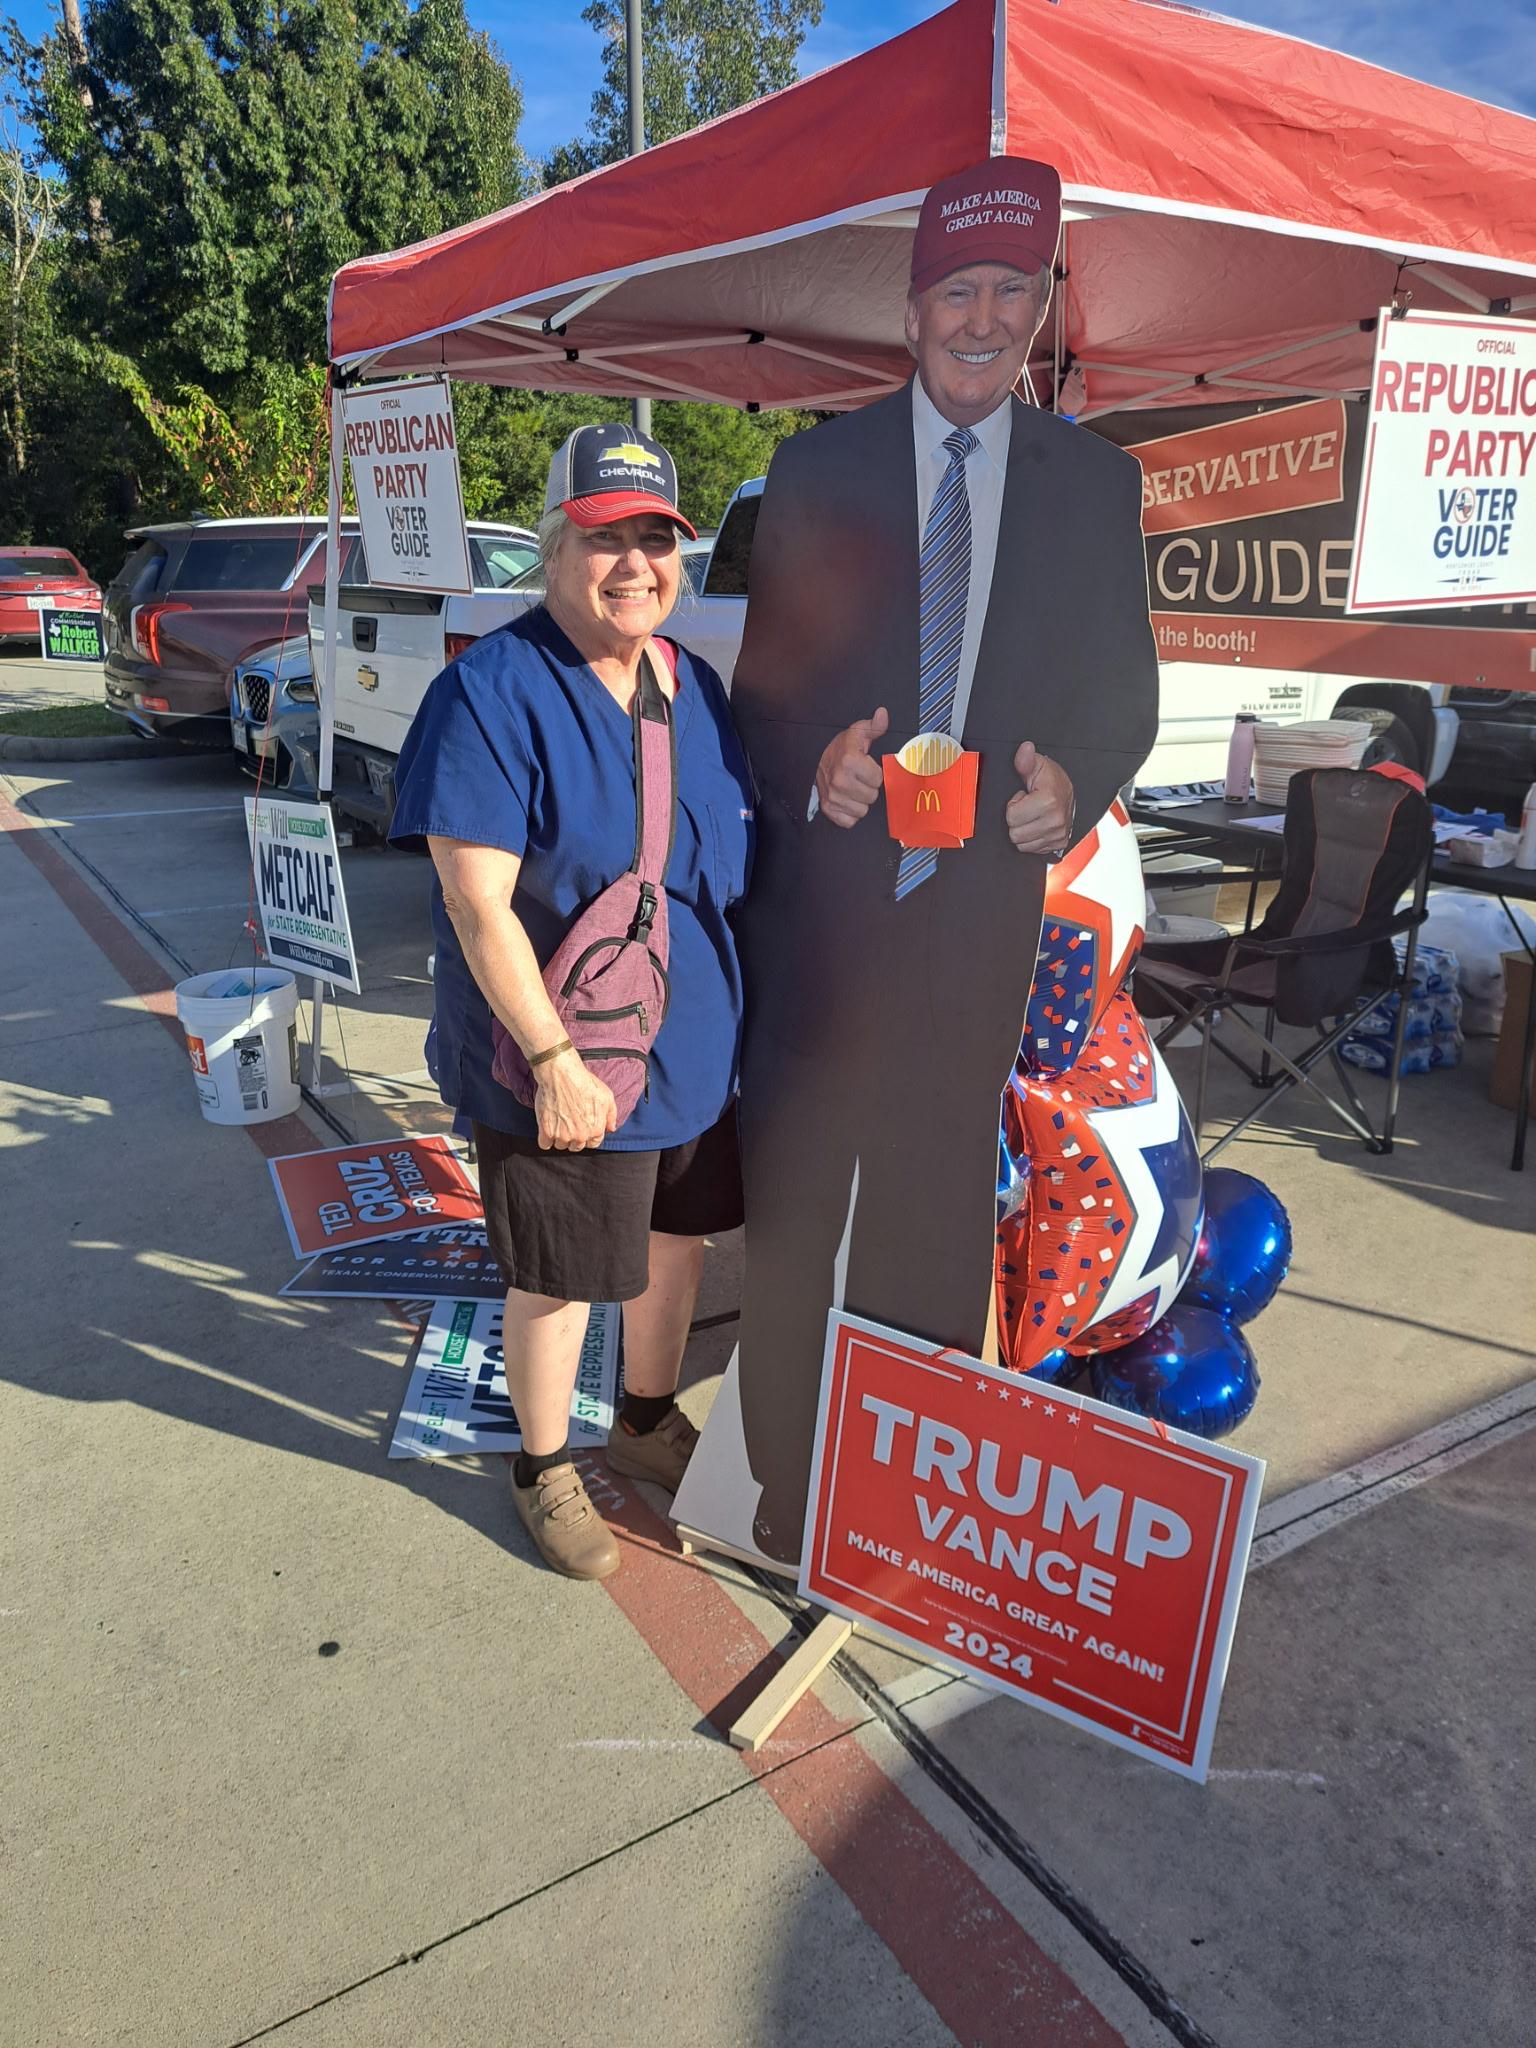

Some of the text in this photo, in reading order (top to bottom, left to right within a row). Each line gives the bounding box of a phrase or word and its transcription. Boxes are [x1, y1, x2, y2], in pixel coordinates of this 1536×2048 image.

[940, 190, 1041, 218] MAKE AMERICA
[946, 210, 1034, 233] GREAT AGAIN
[1477, 339, 1516, 355] OFFICIAL
[380, 398, 401, 410] OFFICIAL
[345, 412, 454, 457] REPUBLICAN
[1424, 429, 1536, 477] PARTY
[373, 463, 427, 498] PARTY
[599, 467, 666, 486] CHEVROLET
[1438, 487, 1518, 524] VOTER
[391, 533, 431, 558] GUIDE
[1433, 524, 1512, 559] GUIDE
[1156, 537, 1354, 607] GUIDE
[50, 618, 95, 626] COMMISSIONER
[61, 624, 98, 640] Robert
[50, 636, 100, 656] WALKER
[1159, 626, 1256, 652] the booth!
[1241, 702, 1302, 711] SILVERADO
[270, 807, 288, 840] Will
[259, 841, 335, 924] METCALF
[276, 916, 295, 933] STATE
[295, 920, 346, 948] REPRESENTATIVE
[338, 1156, 406, 1223] CRUZ
[389, 1151, 442, 1215] FOR TEXAS
[318, 1202, 353, 1236] TED
[321, 1269, 360, 1277] TEXAN
[375, 1270, 465, 1281] CONSERVATIVE
[331, 1255, 386, 1265] FOR
[421, 1363, 471, 1400] Will
[446, 1338, 465, 1359] HOUSE
[577, 1382, 601, 1417] STATE
[578, 1420, 602, 1438] for
[861, 1393, 1193, 1569] TRUMP
[914, 1493, 1118, 1617] VANCE
[847, 1529, 904, 1569] MAKE
[906, 1558, 1001, 1611] AMERICA
[1005, 1601, 1079, 1644] GREAT
[1083, 1636, 1165, 1683] AGAIN!
[944, 1622, 1033, 1680] 2024
